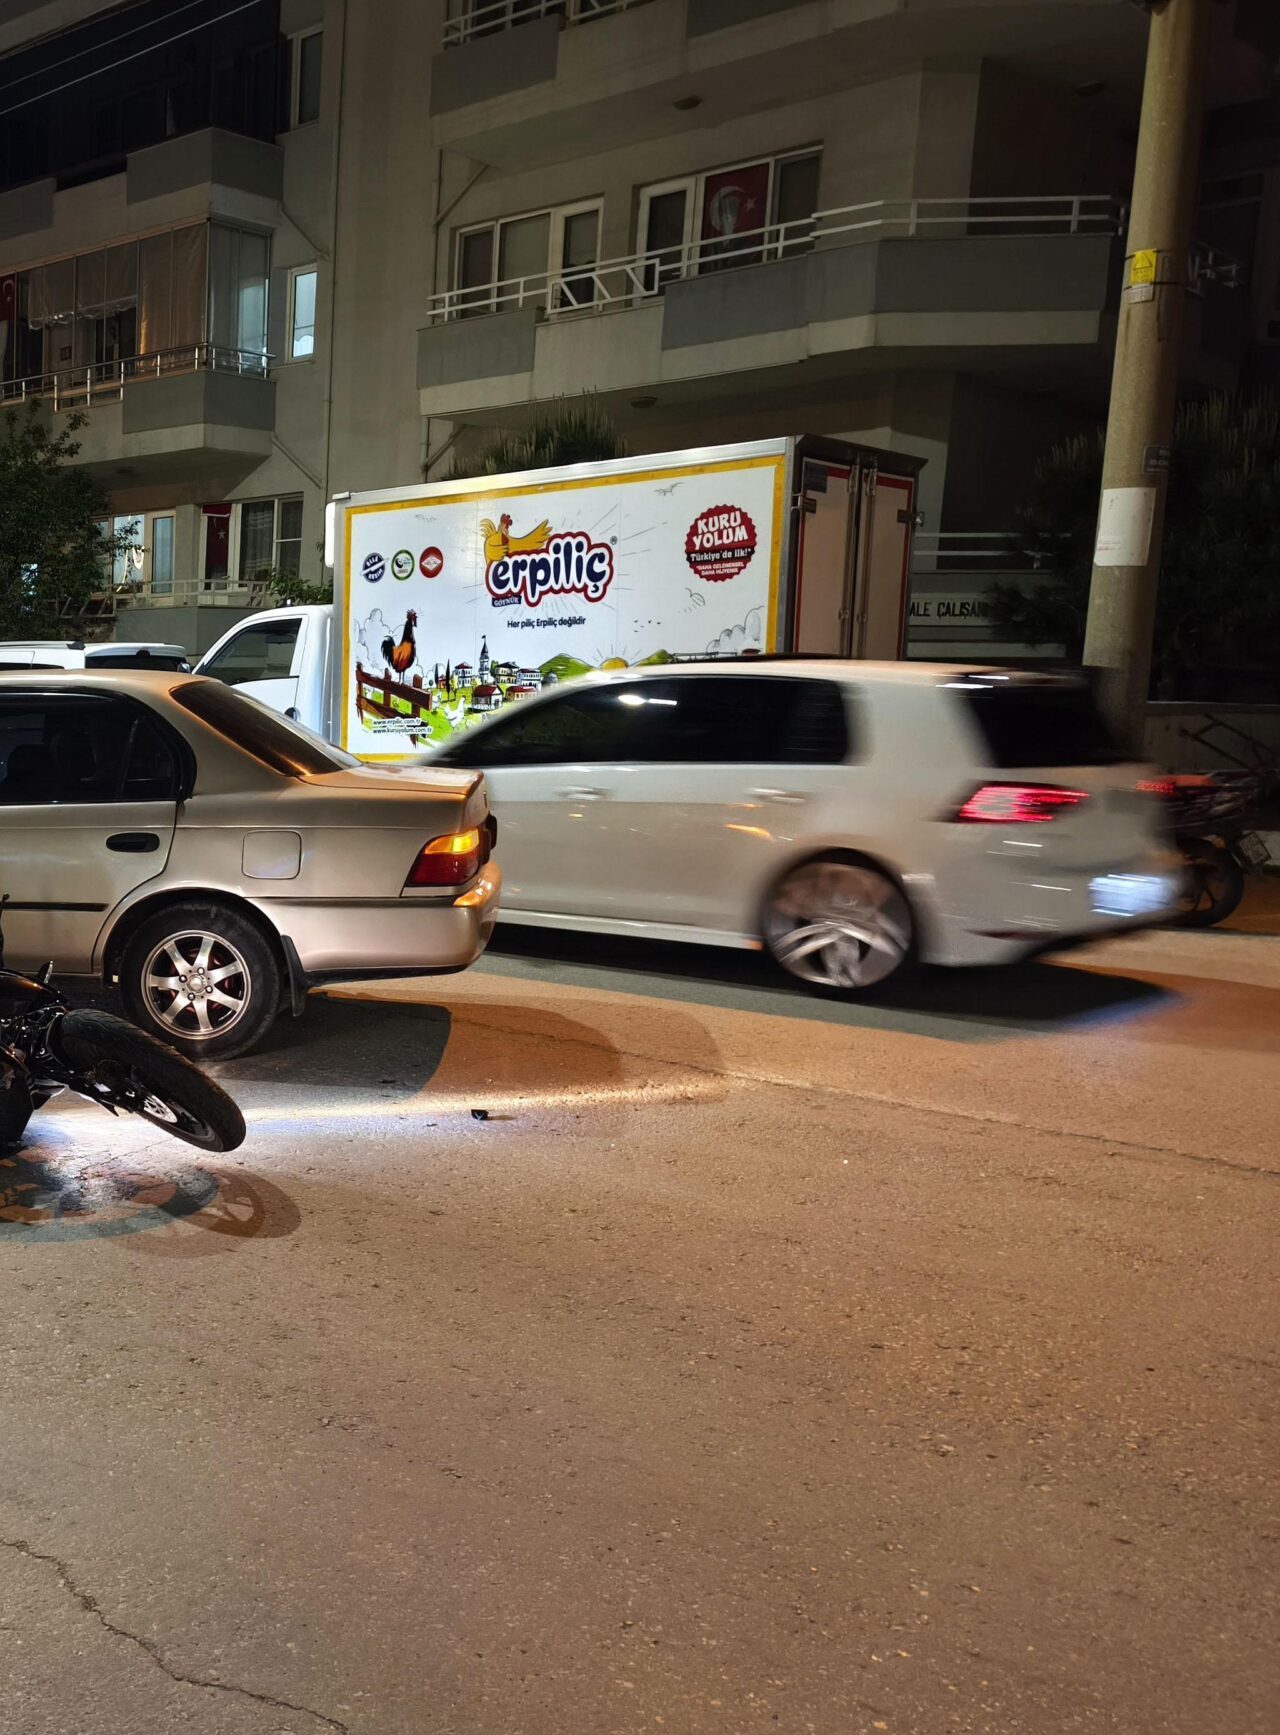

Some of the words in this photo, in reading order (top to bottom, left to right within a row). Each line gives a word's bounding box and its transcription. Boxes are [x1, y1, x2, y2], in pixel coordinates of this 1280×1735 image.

[697, 511, 741, 534] KURU
[692, 525, 748, 550] YOLUM
[492, 541, 606, 598] erpiliç
[507, 619, 520, 628] Her
[521, 619, 535, 629] piliç
[536, 618, 557, 629] Erpiliç
